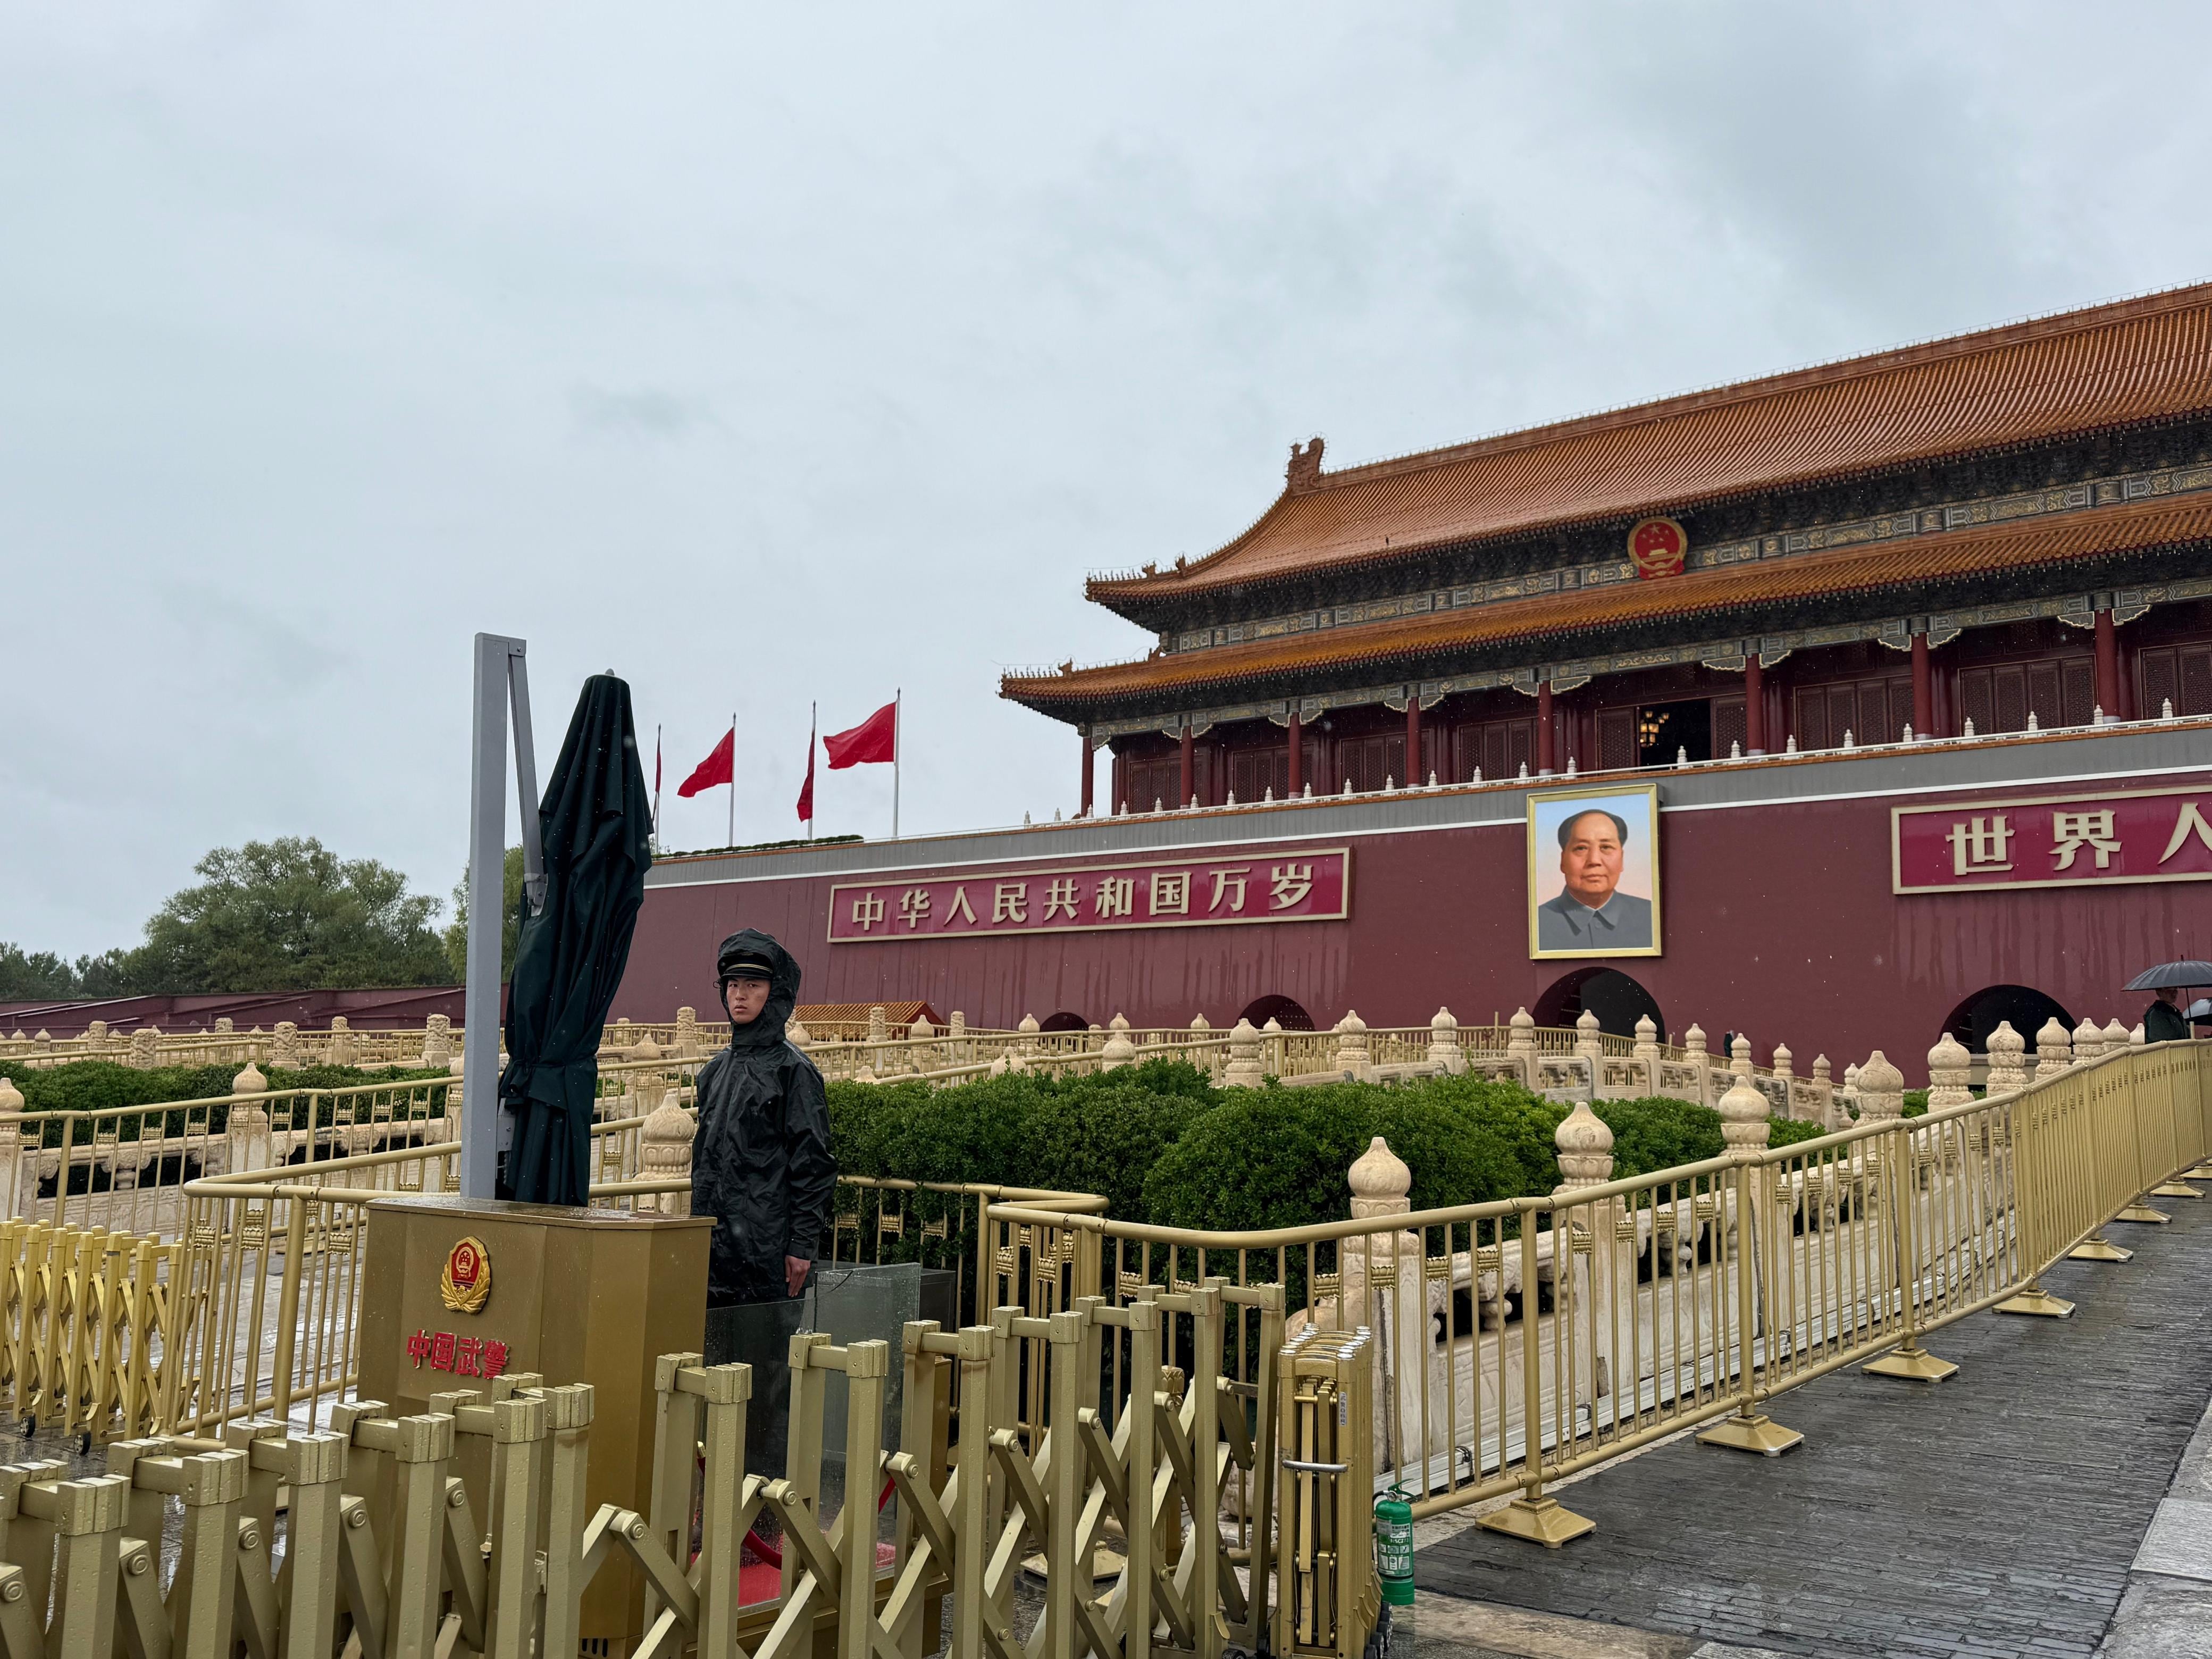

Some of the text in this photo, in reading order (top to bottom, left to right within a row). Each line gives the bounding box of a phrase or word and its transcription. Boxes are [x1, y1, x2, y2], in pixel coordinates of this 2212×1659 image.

[1945, 802, 2212, 876] 世界人
[852, 863, 1314, 932] 中华人民共和国万岁
[406, 1328, 510, 1379] 中国武警
